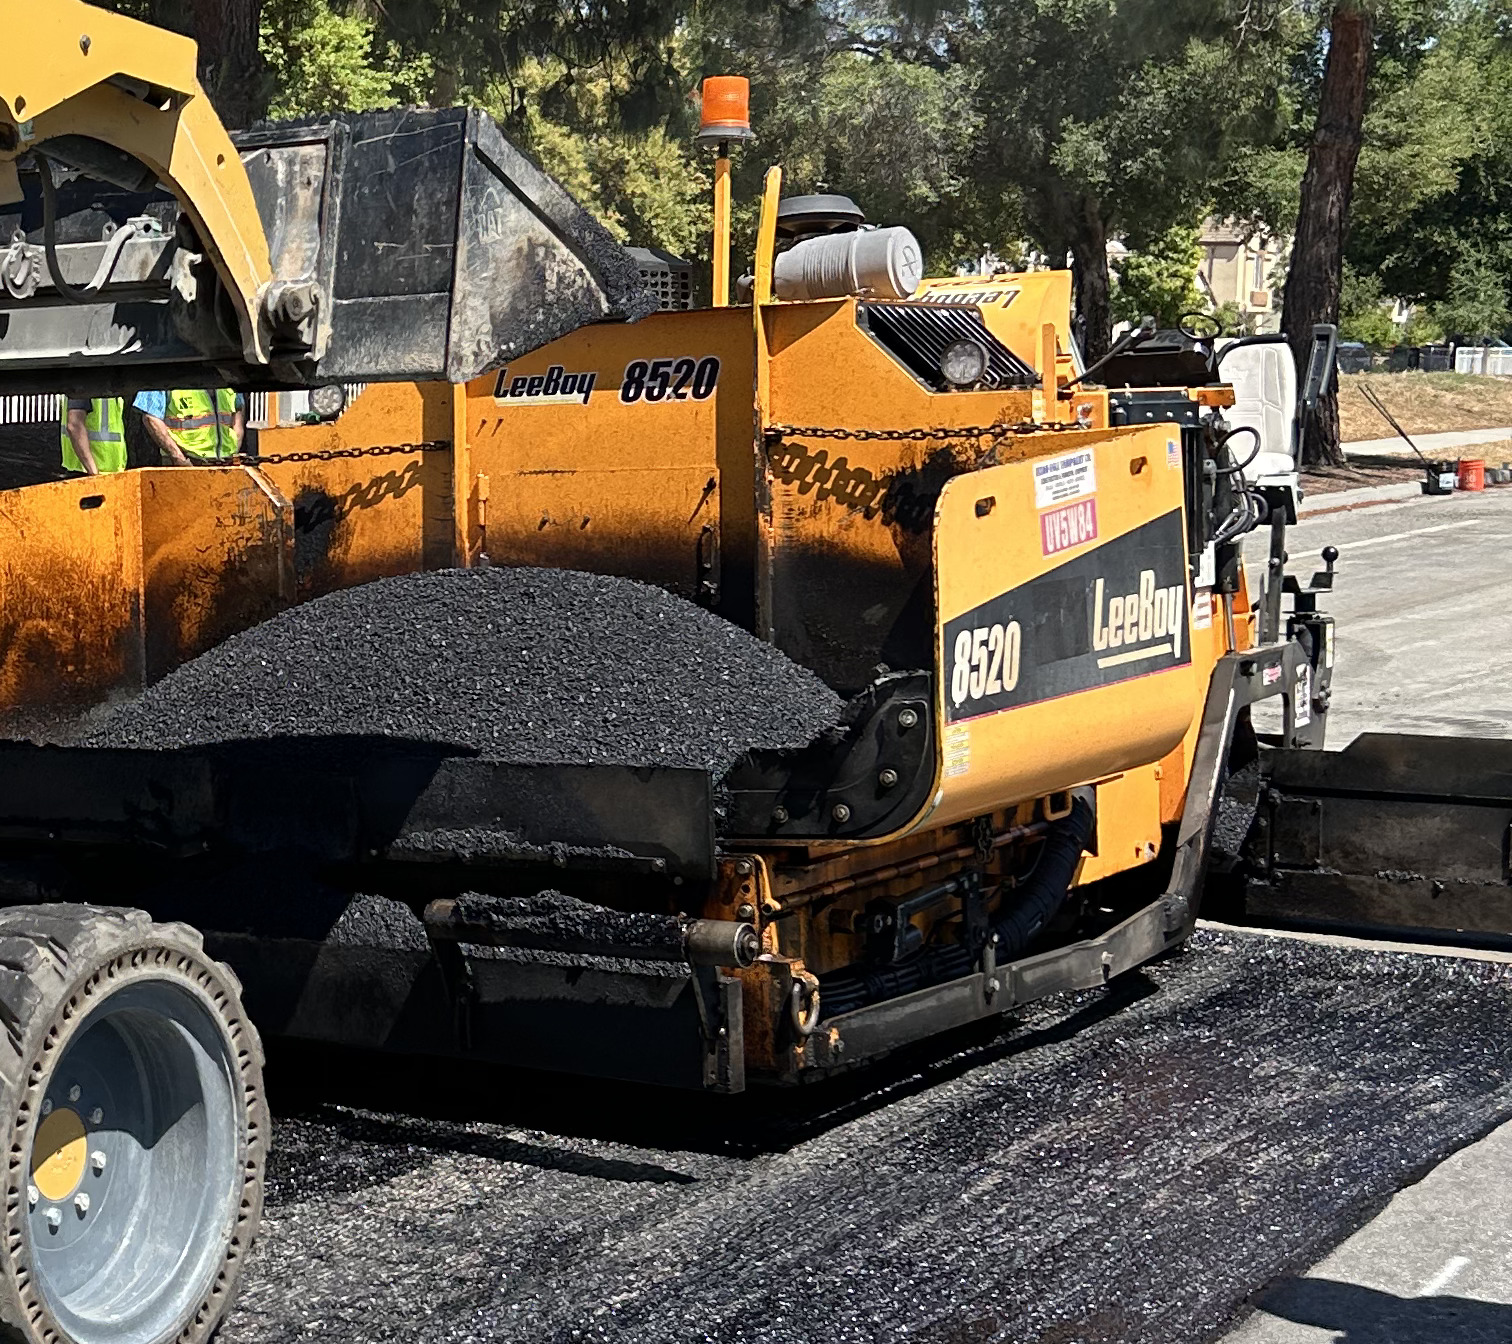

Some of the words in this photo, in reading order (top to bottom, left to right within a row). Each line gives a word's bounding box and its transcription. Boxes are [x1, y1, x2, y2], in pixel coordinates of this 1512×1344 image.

[493, 365, 597, 405] LeeBoy
[620, 357, 720, 403] 8520
[1045, 502, 1093, 552] UV5W84
[1093, 569, 1184, 659] LeeBoy
[951, 621, 1022, 705] 8520
